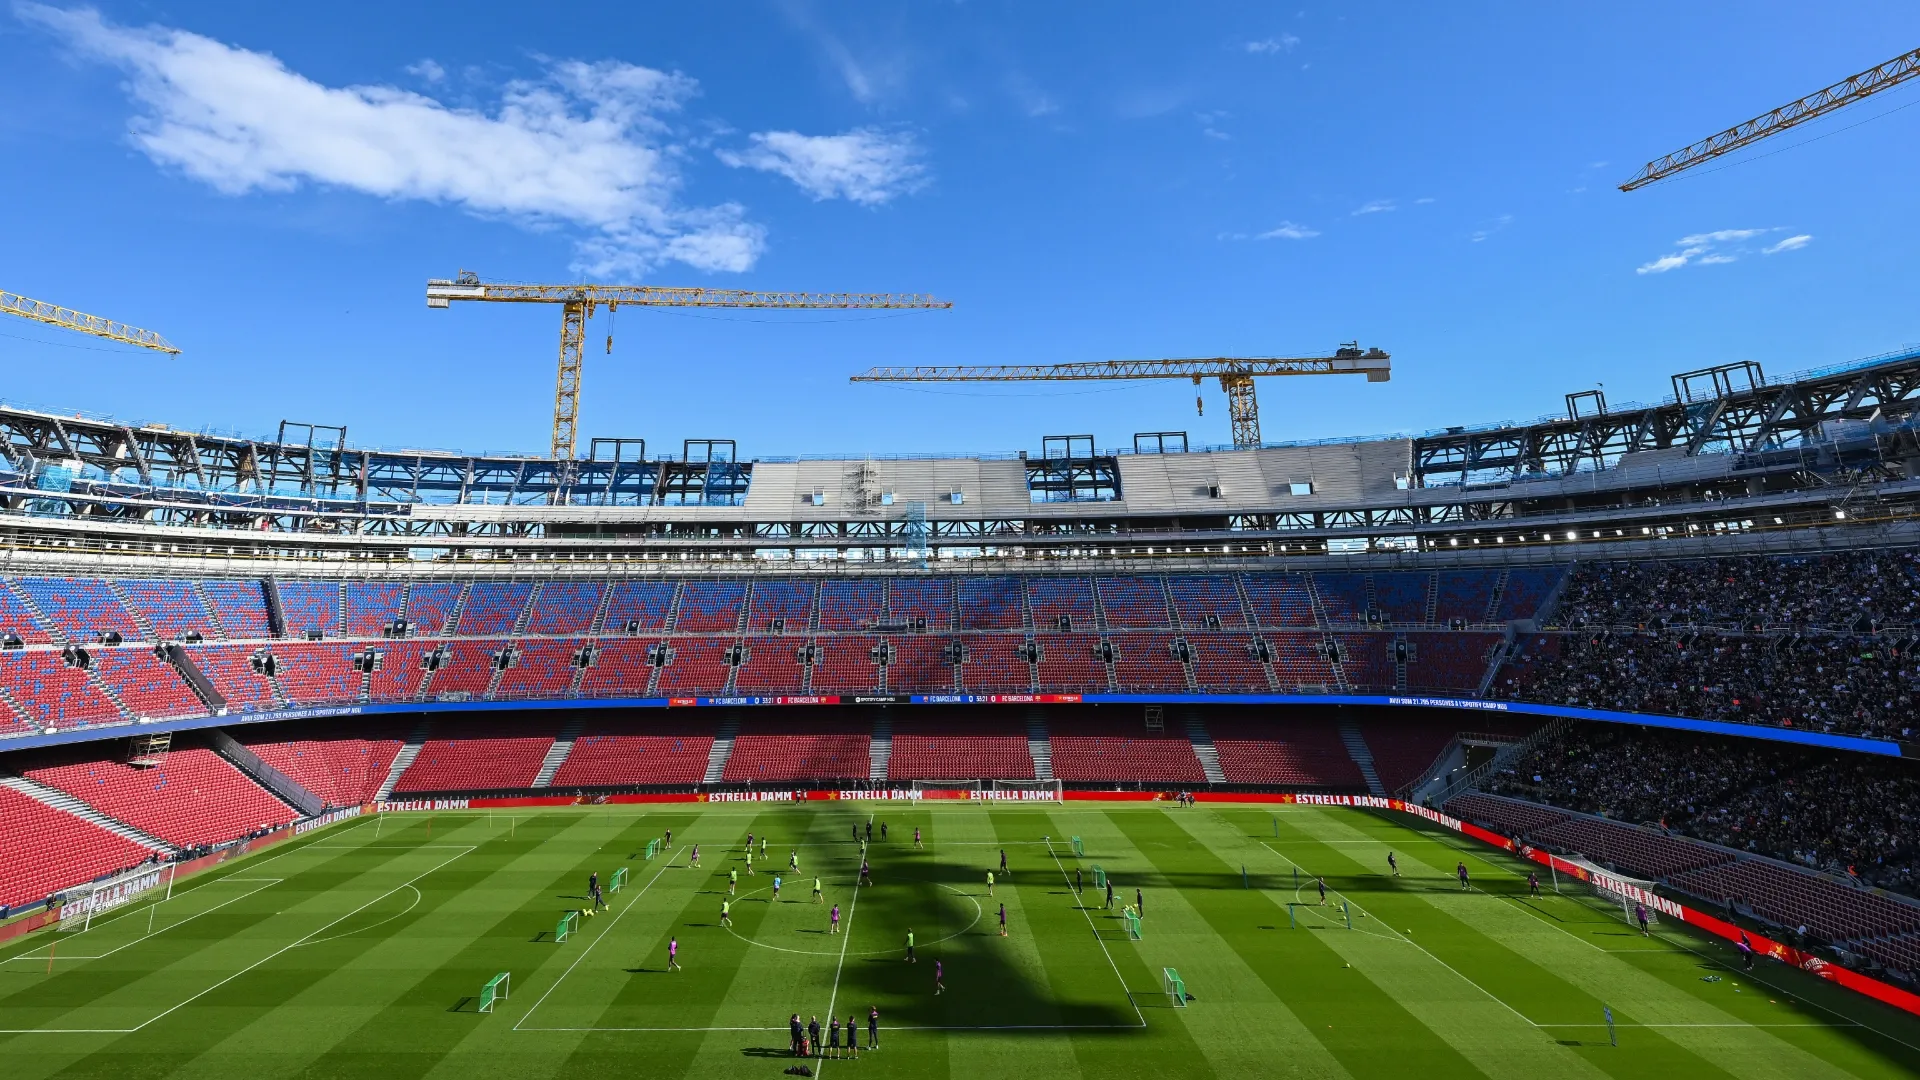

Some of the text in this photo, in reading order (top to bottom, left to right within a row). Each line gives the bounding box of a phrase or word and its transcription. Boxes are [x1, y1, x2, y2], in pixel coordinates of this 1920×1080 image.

[722, 697, 747, 705] BARCELONA
[794, 696, 819, 704] BARCELONA
[708, 791, 793, 802] ESTRELLA DAMM
[839, 790, 923, 801] ESTRELLA DAMM
[969, 790, 1054, 801] ESTRELLA DAMM
[1295, 794, 1390, 808] ESTRELLA DAMM
[377, 800, 469, 812] ESTRELLA DAMM
[295, 806, 361, 835] ESTRELLA DAMM
[1405, 802, 1462, 832] ESTRELLA DAMM
[60, 872, 160, 920] ESTRELLA DAMM
[1643, 890, 1685, 920] DAMM
